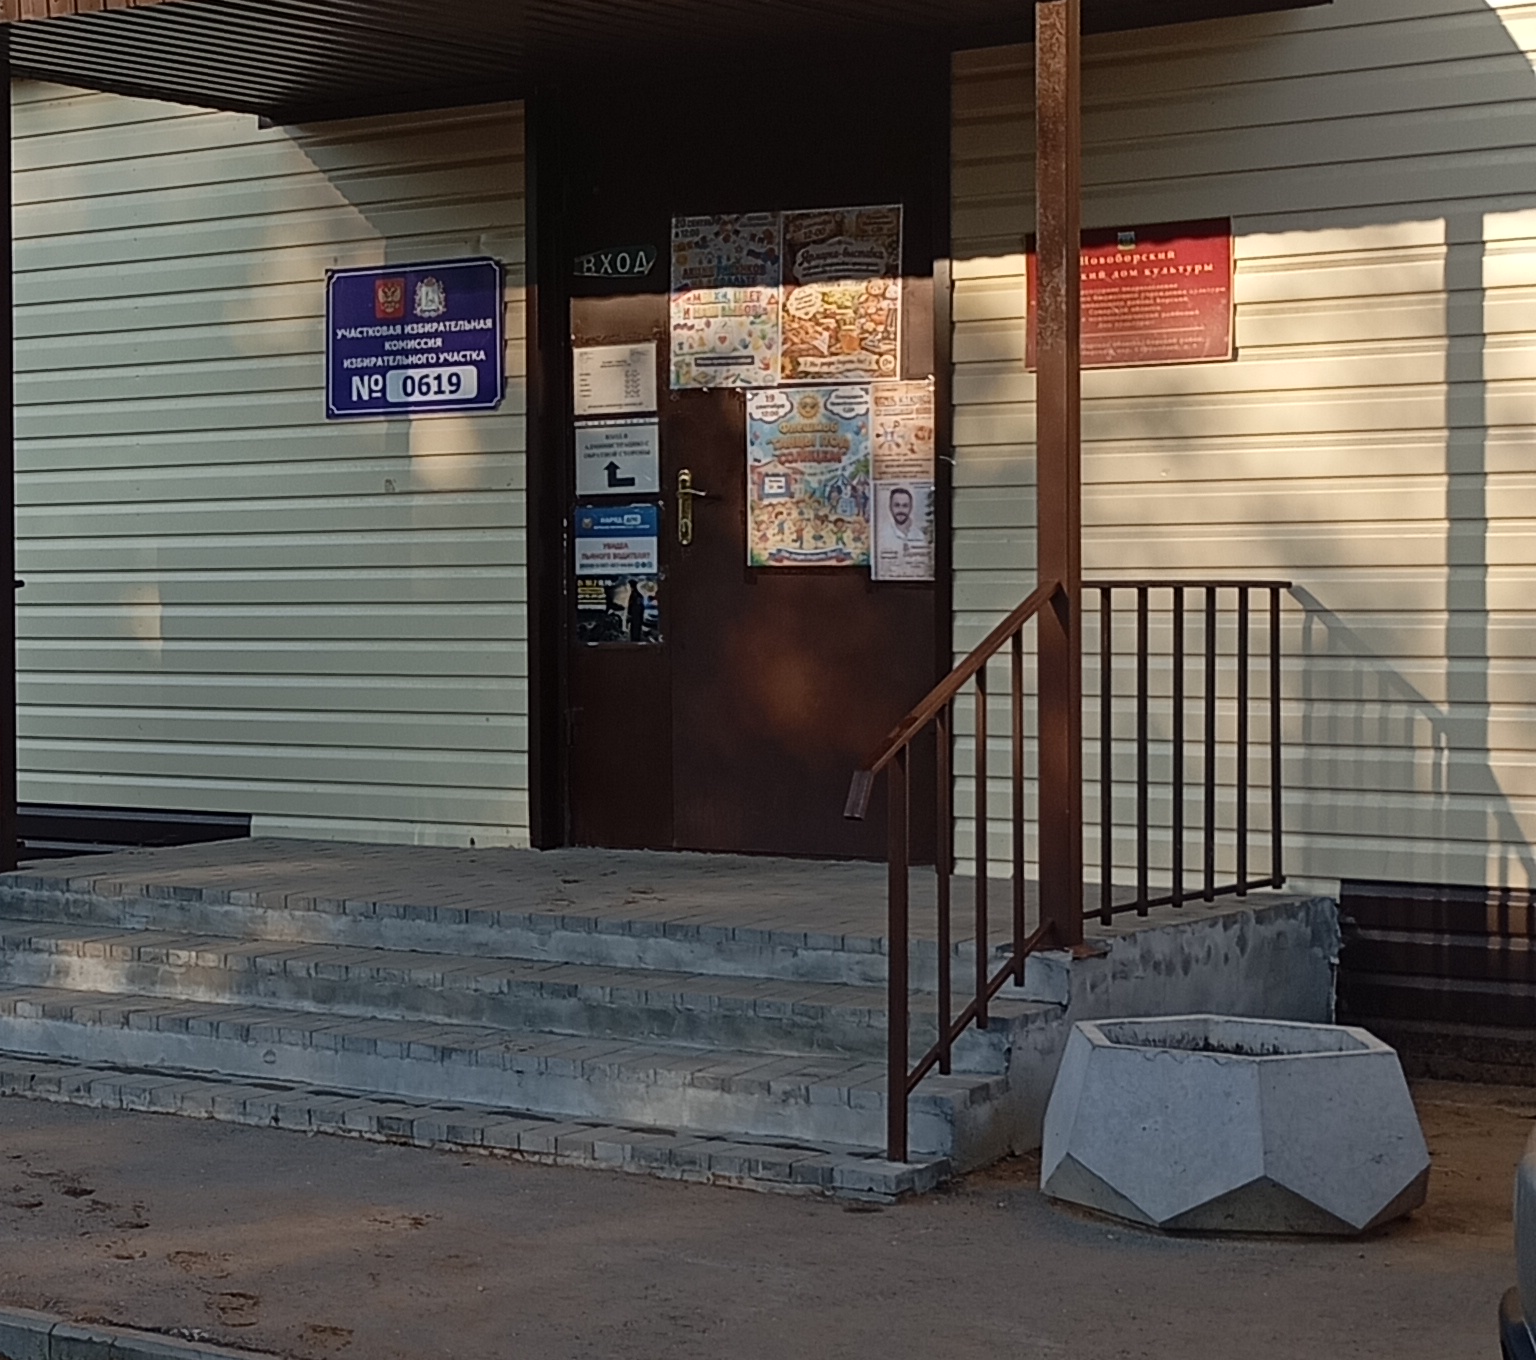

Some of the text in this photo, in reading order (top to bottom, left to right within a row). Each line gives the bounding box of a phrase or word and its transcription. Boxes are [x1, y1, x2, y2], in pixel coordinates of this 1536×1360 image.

[583, 251, 647, 274] ВХОД
[1111, 268, 1138, 279] дом
[1144, 263, 1213, 278] культуры
[336, 318, 492, 339] УЧАСТКОВАЯ ИЗБИРАТЕЛЬНАЯ
[384, 338, 442, 351] КОМИССИЯ
[343, 350, 486, 369] ИЗБИРАТЕЛЬНОГО УЧАСТКА
[351, 372, 461, 401] № 0619
